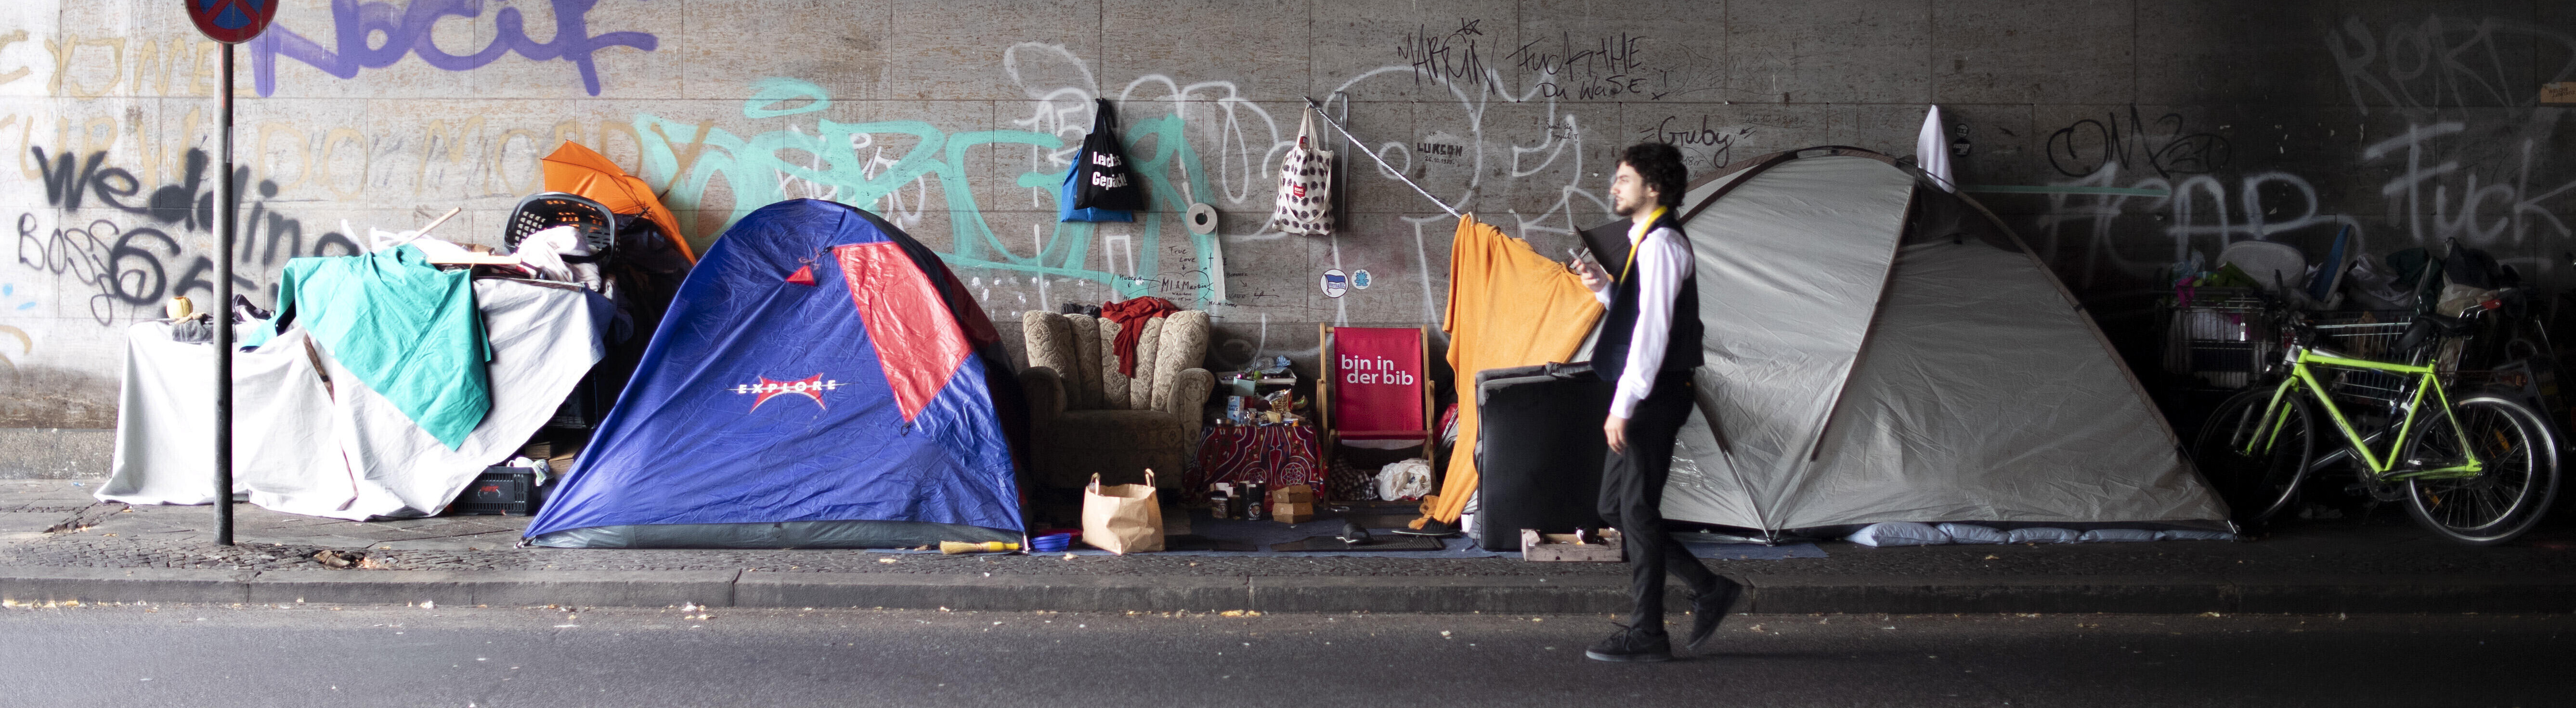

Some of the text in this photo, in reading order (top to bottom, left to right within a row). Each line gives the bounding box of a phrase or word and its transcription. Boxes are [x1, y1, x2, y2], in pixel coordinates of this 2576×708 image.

[1169, 246, 1187, 255] True
[1341, 355, 1394, 370] bin in
[1347, 370, 1413, 386] der bib
[739, 380, 836, 394] EXPLORE
